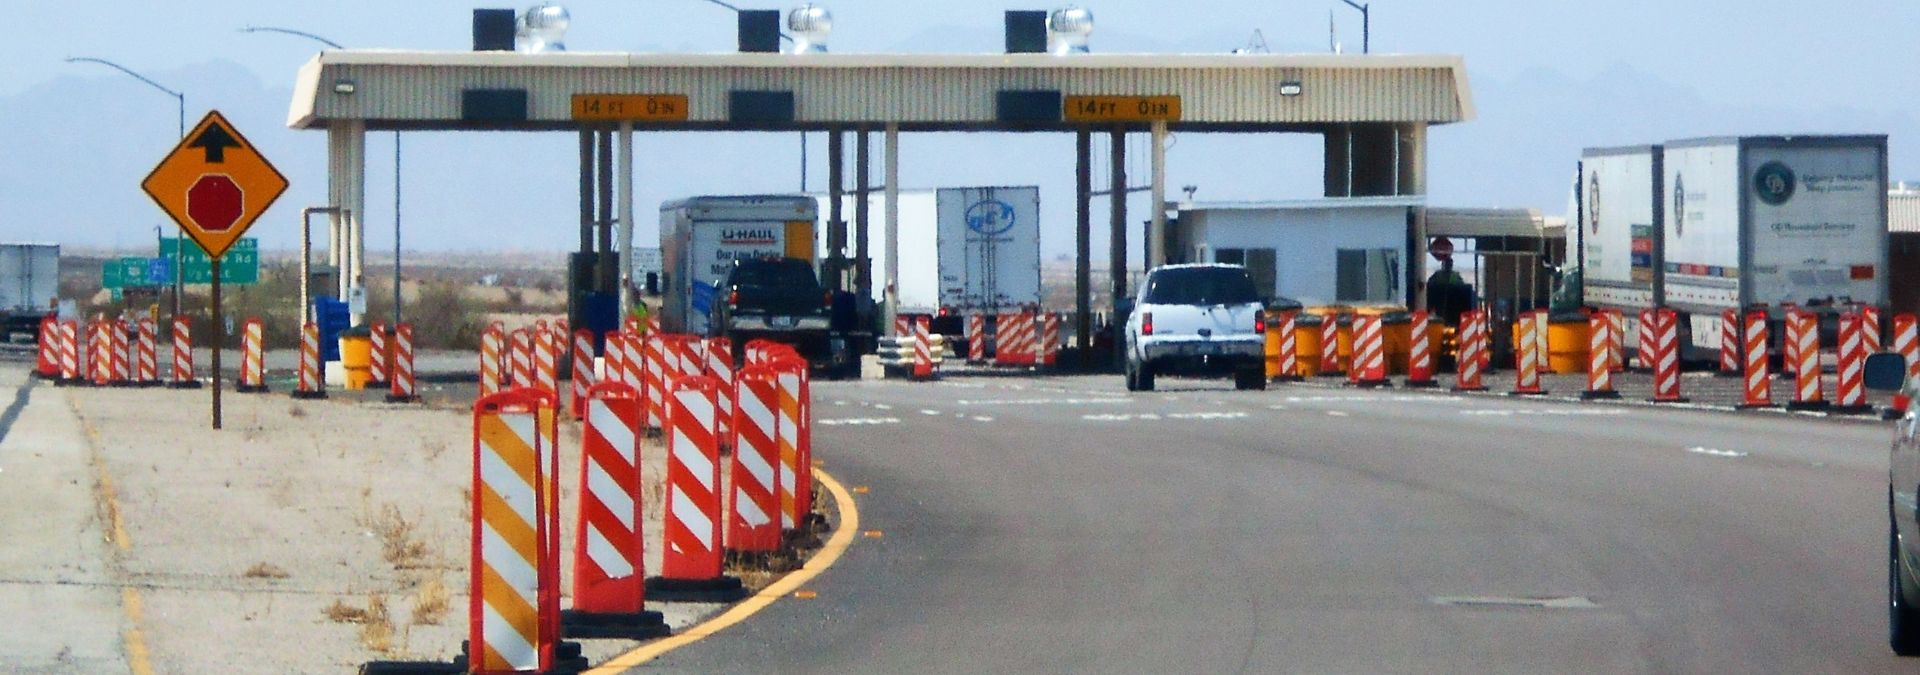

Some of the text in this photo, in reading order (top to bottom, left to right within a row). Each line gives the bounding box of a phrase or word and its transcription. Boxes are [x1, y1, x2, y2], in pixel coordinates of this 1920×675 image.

[582, 99, 599, 113] 14
[1078, 100, 1096, 115] 14
[722, 229, 776, 239] U-HAUL
